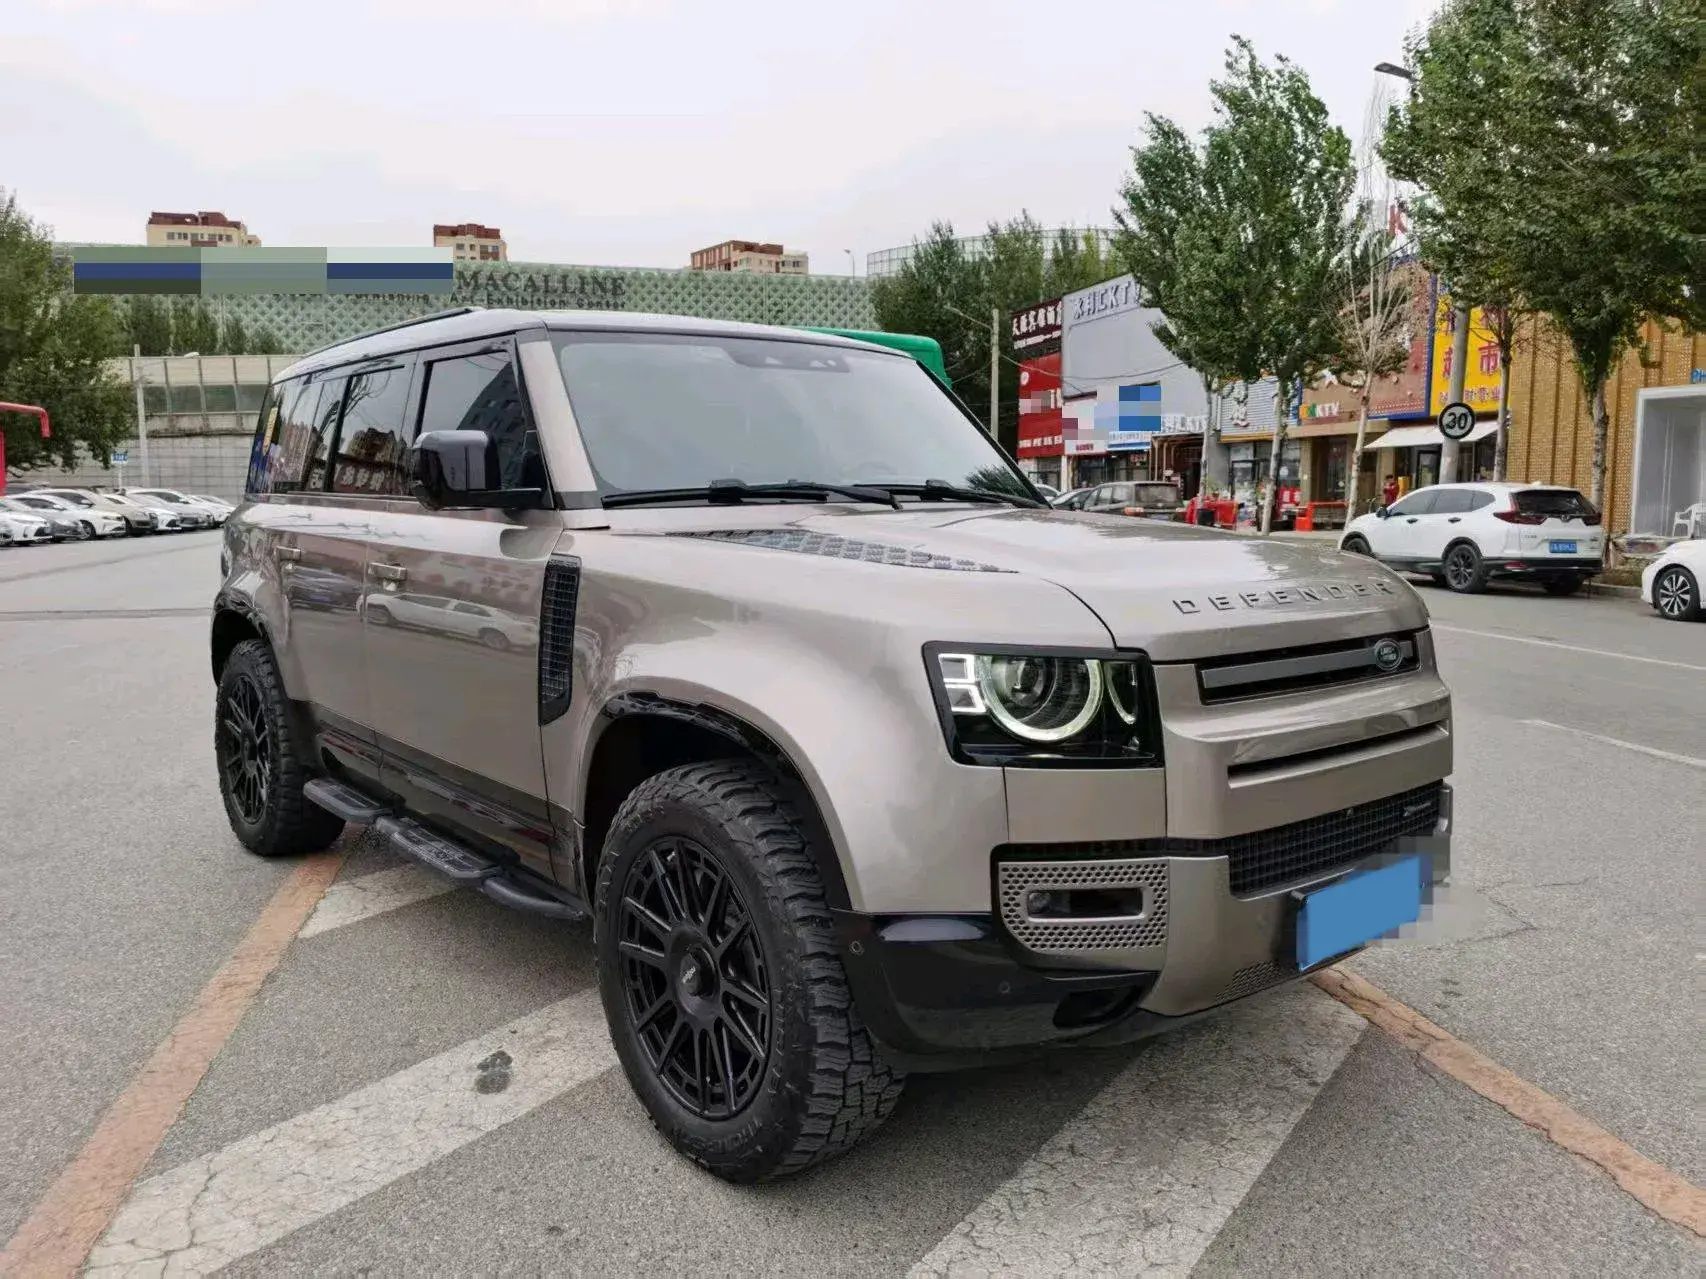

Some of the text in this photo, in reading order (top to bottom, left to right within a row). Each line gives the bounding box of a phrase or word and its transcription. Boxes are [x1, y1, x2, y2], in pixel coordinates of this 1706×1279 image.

[457, 270, 626, 296] MACALLINE
[486, 293, 567, 307] Exhibition
[575, 297, 627, 309] Center
[1445, 412, 1469, 430] 30
[1172, 582, 1395, 615] DEFENDER
